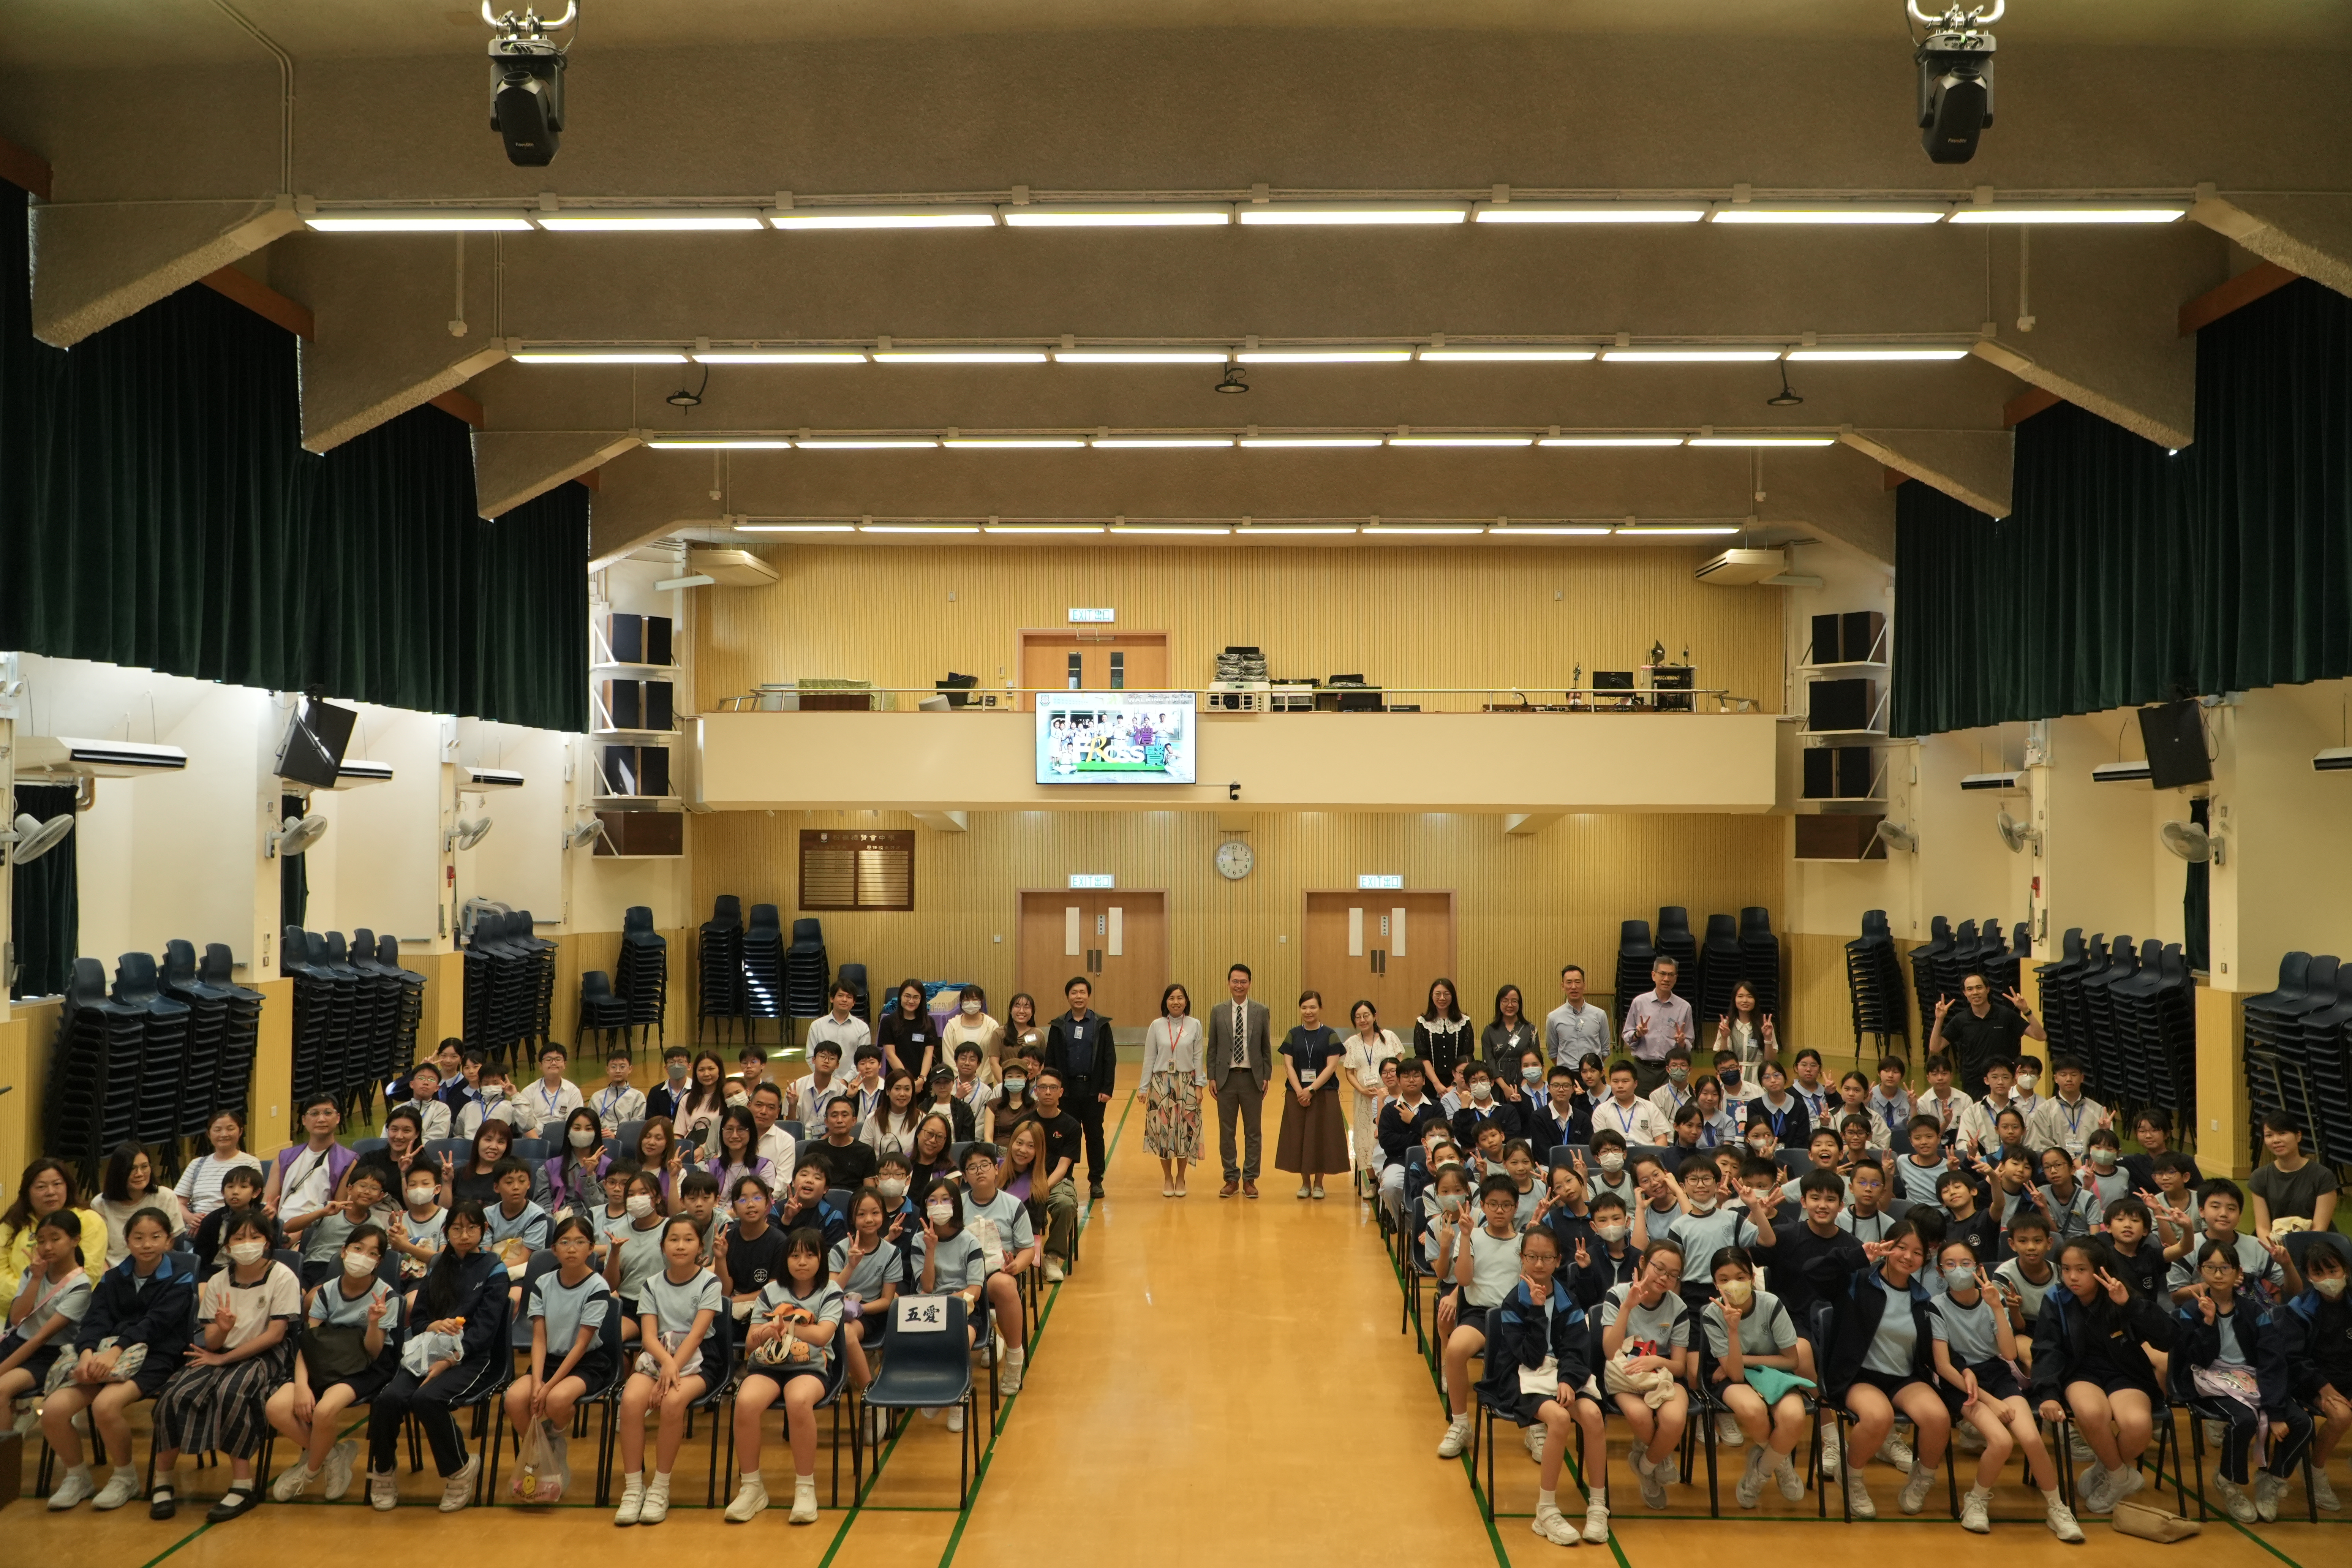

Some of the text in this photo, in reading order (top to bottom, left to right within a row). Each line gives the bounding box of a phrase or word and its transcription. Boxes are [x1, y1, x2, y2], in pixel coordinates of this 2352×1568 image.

[1073, 610, 1110, 620] EXIT 出口
[1073, 877, 1109, 886] EXIT 出口
[1362, 877, 1398, 887] EXIT 出口
[905, 1304, 940, 1323] 五愛
